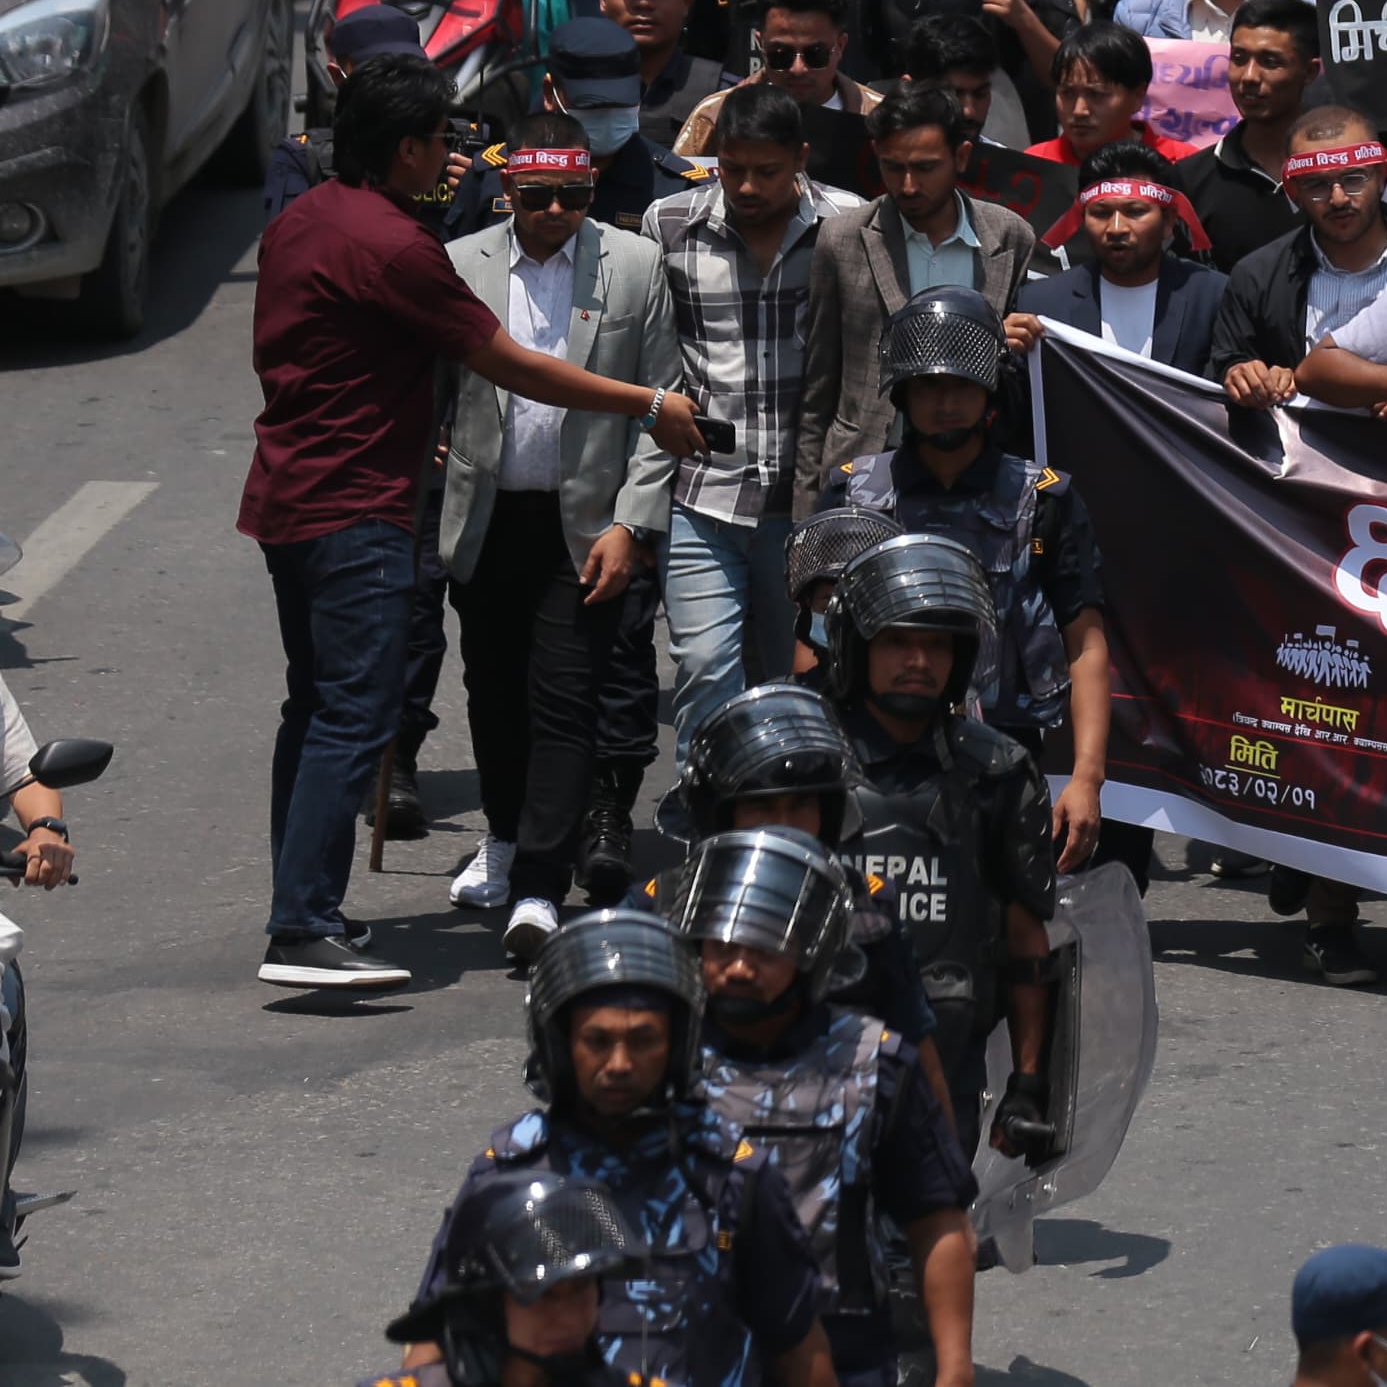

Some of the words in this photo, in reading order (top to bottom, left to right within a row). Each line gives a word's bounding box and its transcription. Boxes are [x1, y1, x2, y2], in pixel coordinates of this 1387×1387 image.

[535, 151, 569, 167] विरुद्ध
[1315, 150, 1349, 166] विरुद्ध
[1100, 181, 1132, 195] विरुद्ध
[1279, 695, 1361, 733] मार्चपास
[1294, 722, 1311, 738] देखि
[1229, 734, 1279, 771] मिति
